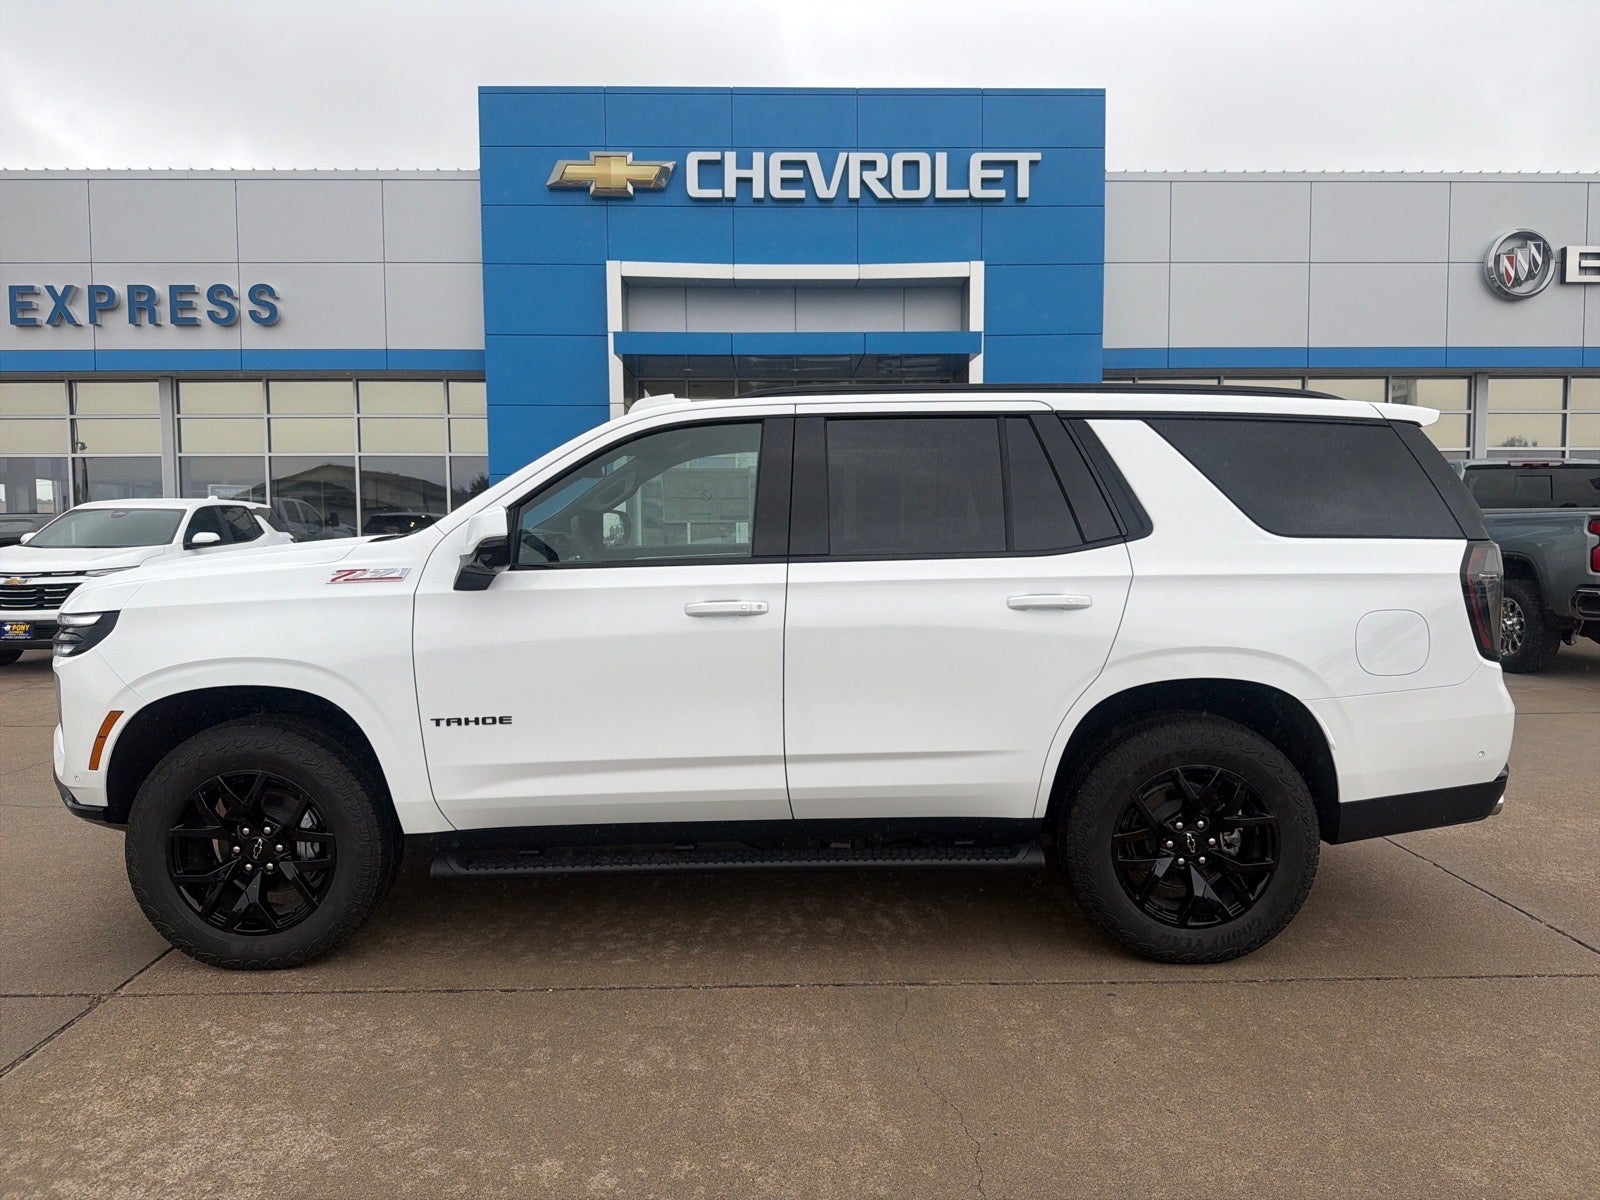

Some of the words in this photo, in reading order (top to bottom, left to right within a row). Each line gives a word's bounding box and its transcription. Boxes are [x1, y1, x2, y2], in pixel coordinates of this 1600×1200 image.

[685, 151, 1042, 199] CHEVROLET
[8, 283, 281, 327] EXPRESS
[325, 567, 412, 585] Z71
[430, 715, 513, 727] TAHOE
